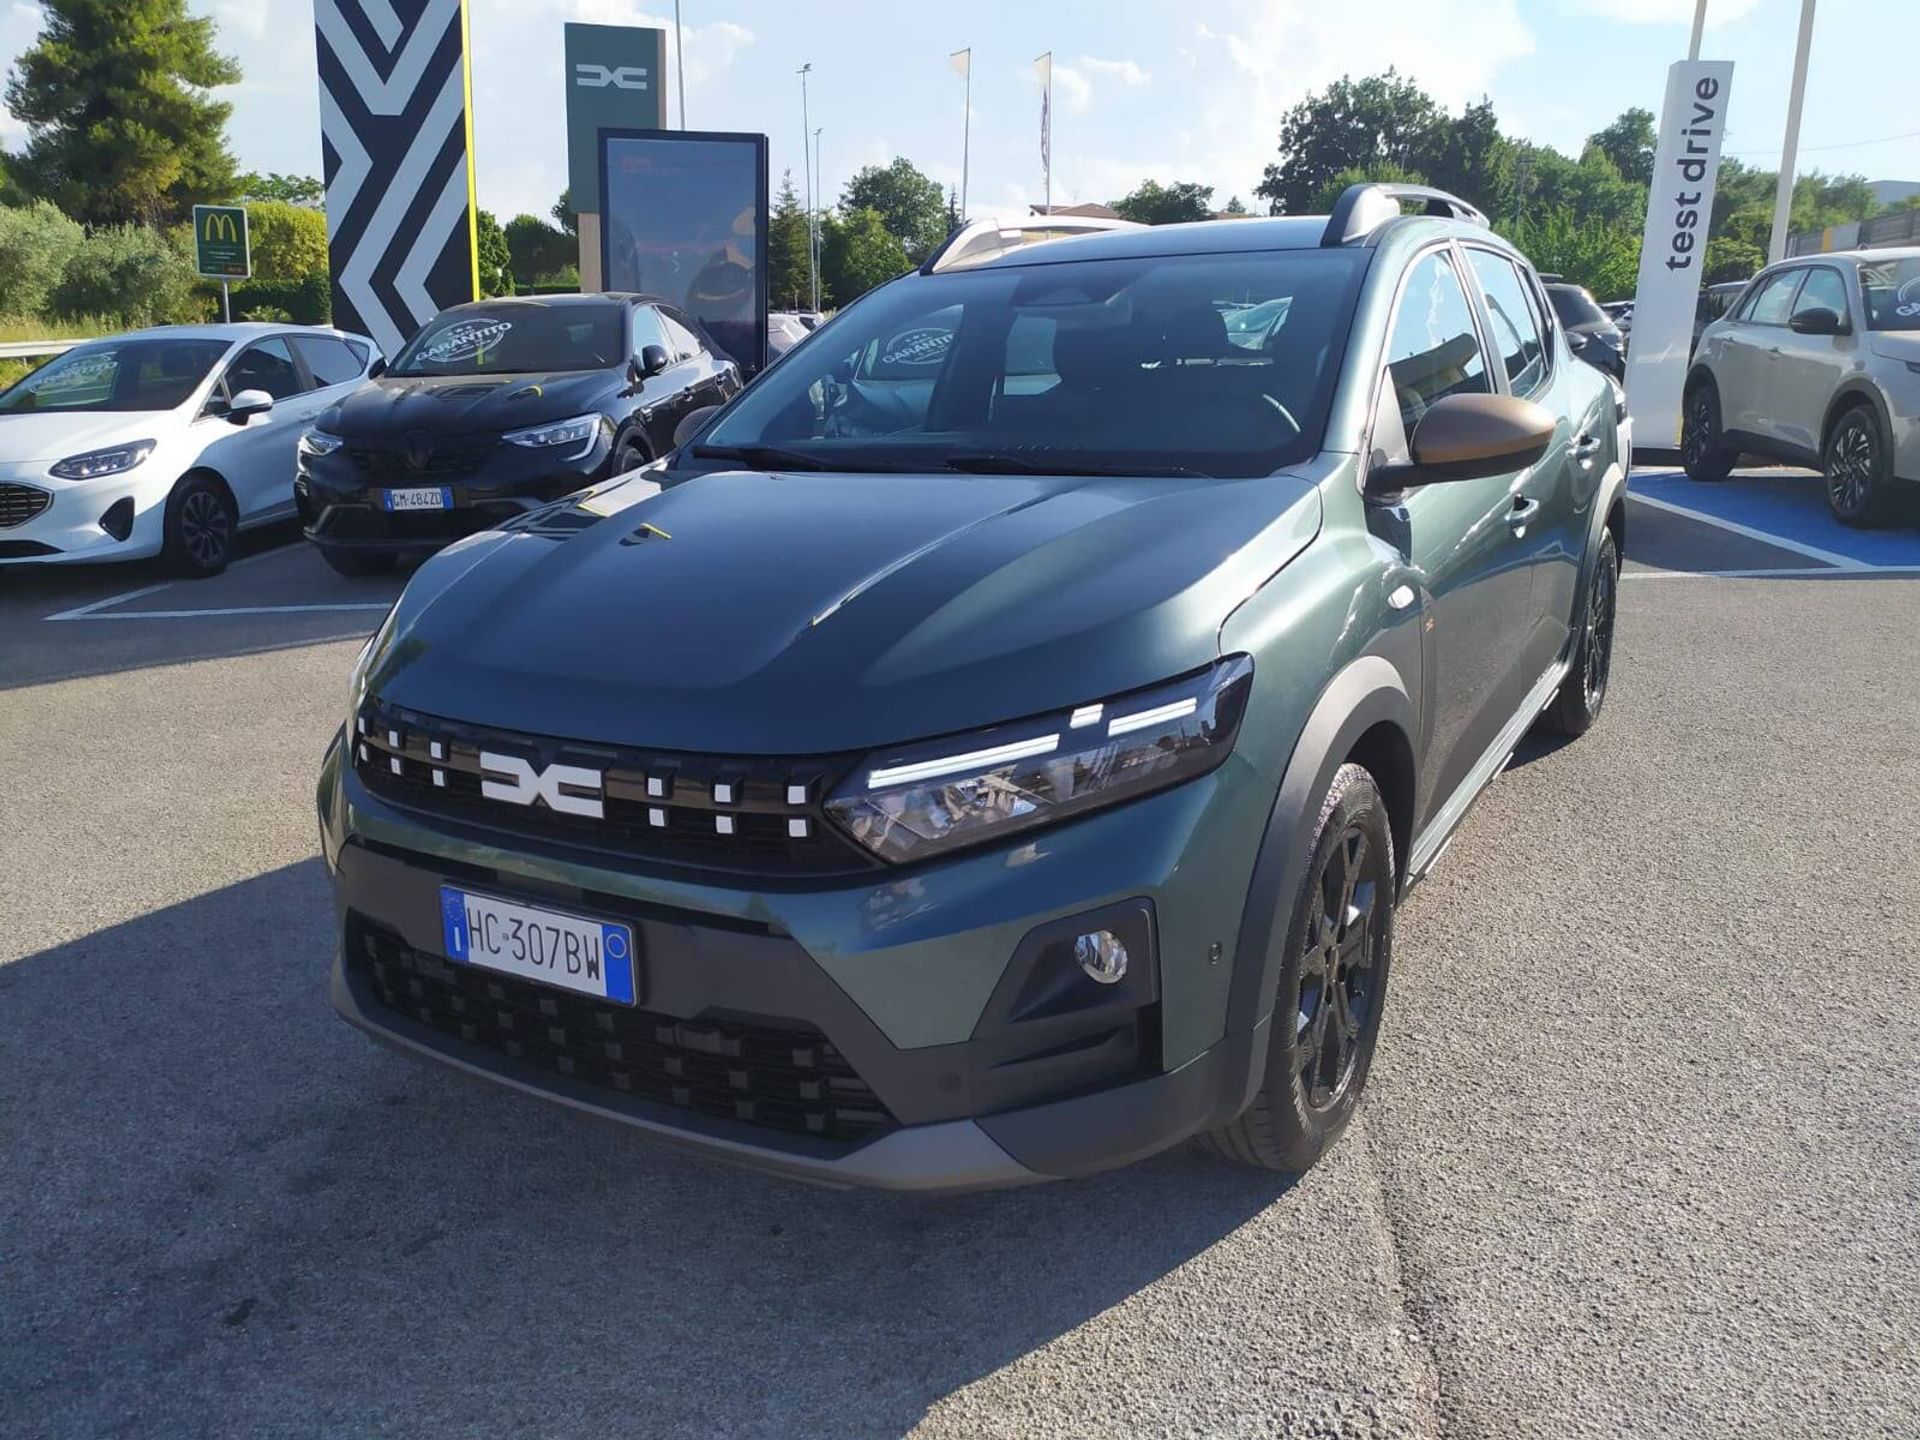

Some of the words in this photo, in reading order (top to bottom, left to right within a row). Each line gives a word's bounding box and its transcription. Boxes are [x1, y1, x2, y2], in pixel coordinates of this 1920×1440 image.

[1676, 76, 1719, 183] drive
[1665, 191, 1702, 272] test
[415, 322, 513, 361] GARANTITO
